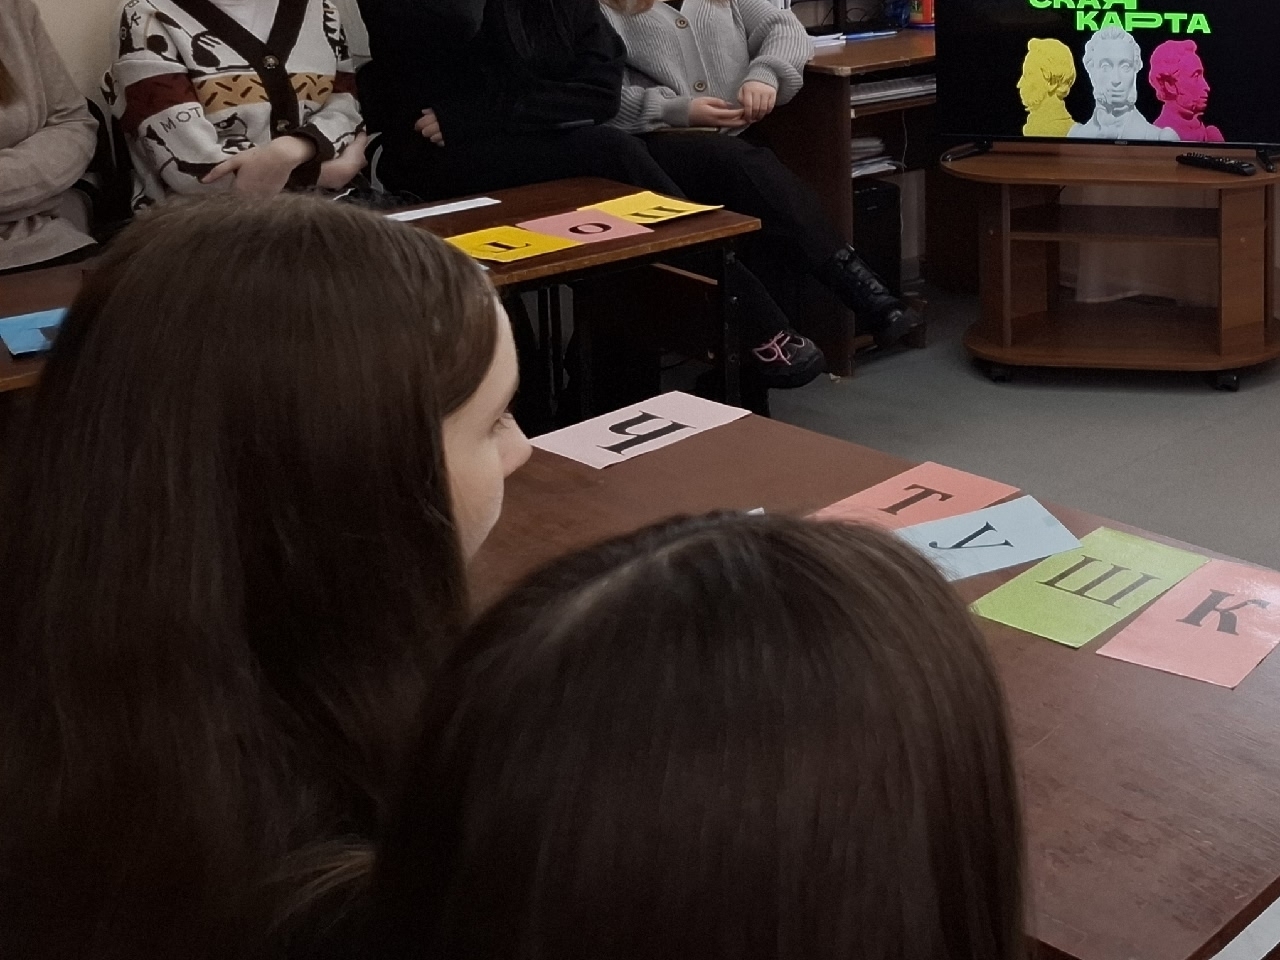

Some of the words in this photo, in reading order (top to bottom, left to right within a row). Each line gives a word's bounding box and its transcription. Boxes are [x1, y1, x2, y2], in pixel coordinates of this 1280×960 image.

[1076, 11, 1212, 34] КАРТА
[596, 409, 697, 456] Ч
[878, 484, 953, 515] Т
[928, 521, 1014, 550] У
[1035, 554, 1161, 609] Ш
[1175, 588, 1272, 636] К
